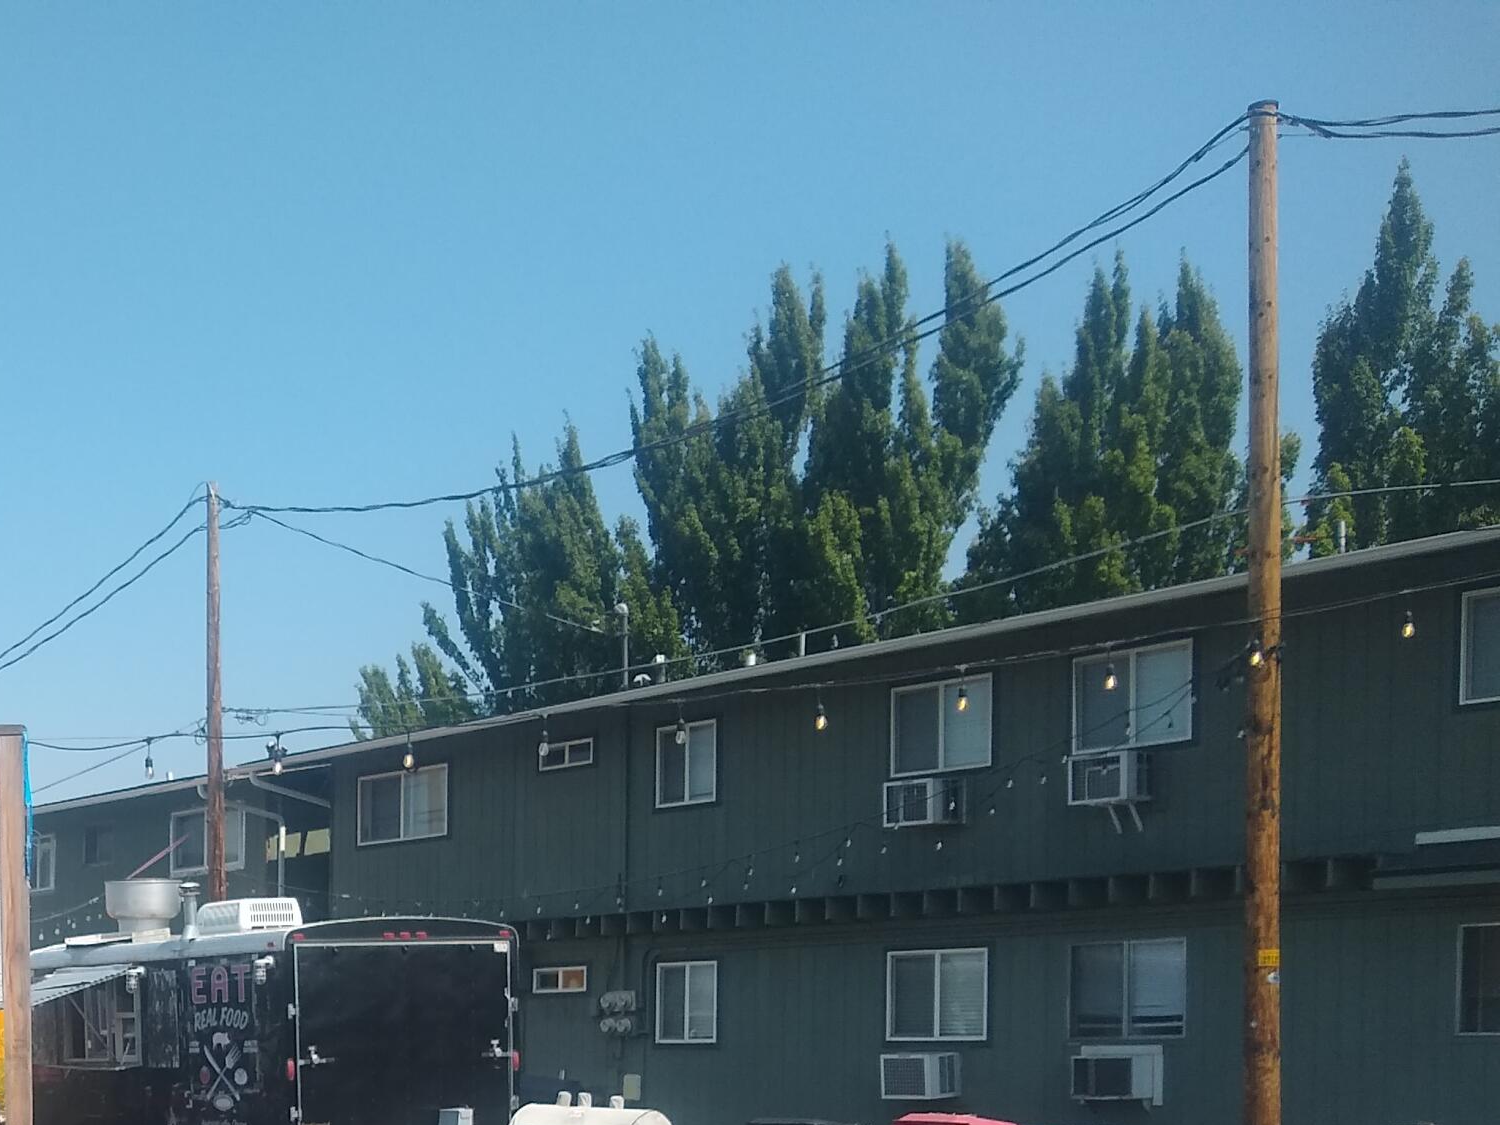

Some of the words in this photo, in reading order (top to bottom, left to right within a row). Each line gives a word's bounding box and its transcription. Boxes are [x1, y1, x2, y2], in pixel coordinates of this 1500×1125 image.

[190, 964, 250, 1004] EAT
[194, 1006, 218, 1032] REAL
[219, 1006, 249, 1030] FOOD
